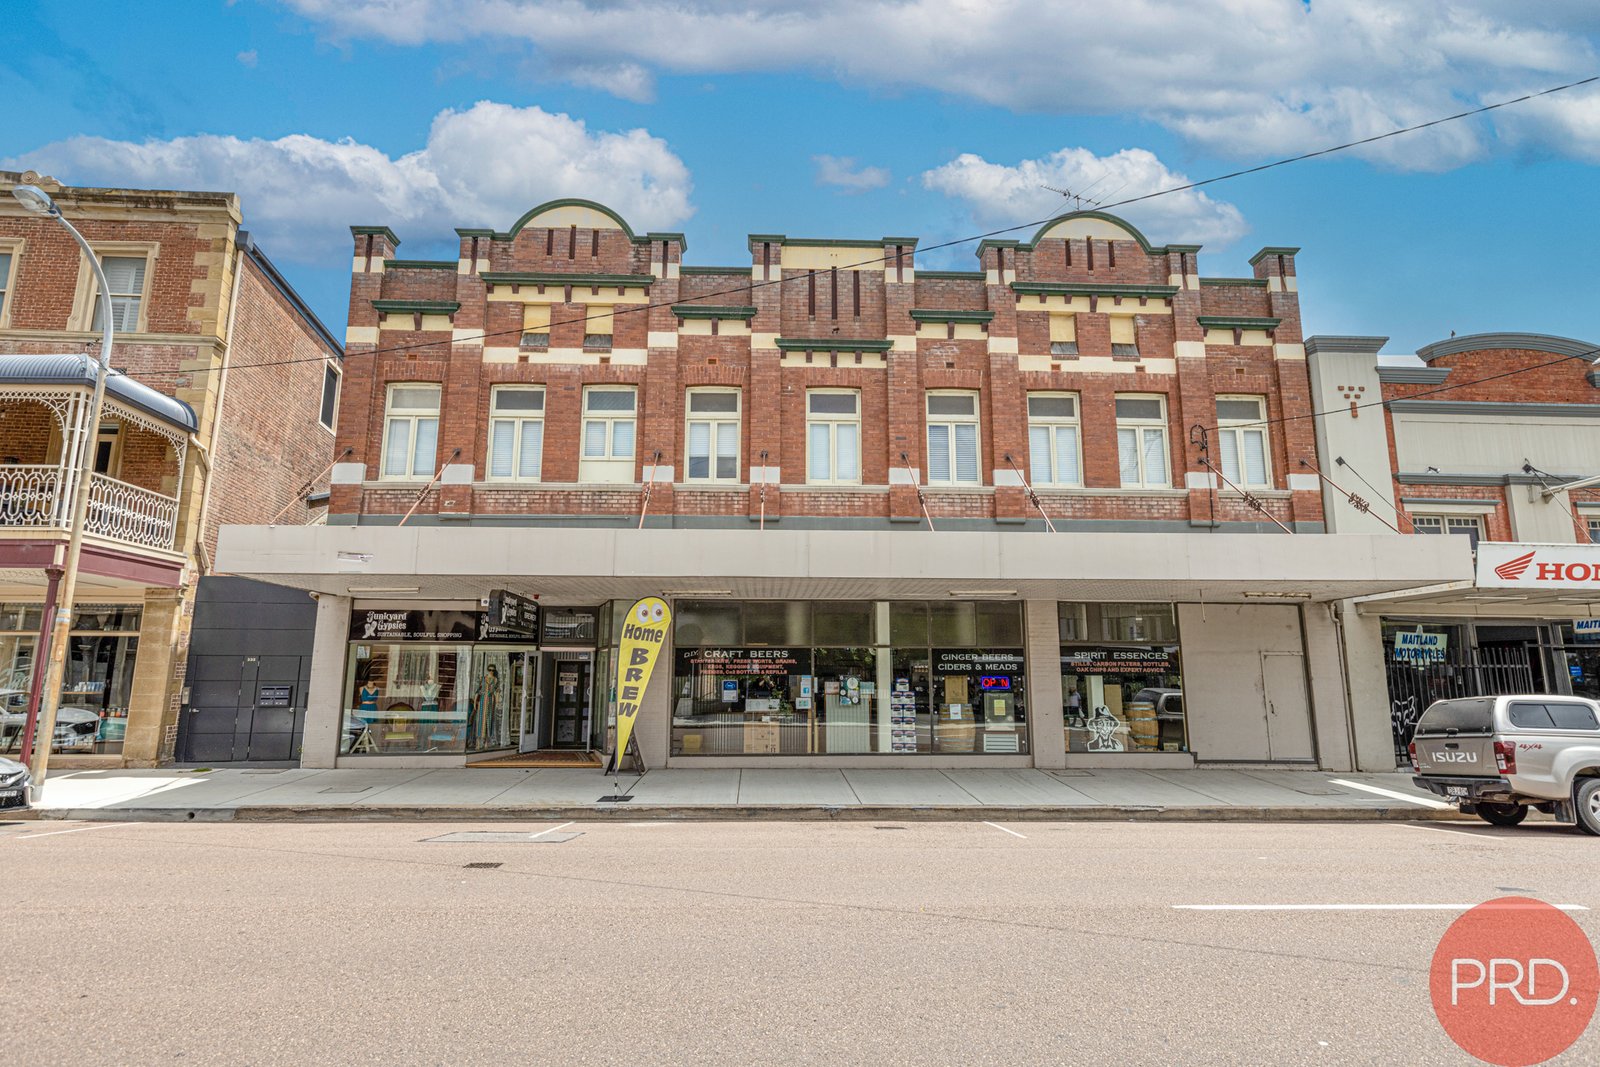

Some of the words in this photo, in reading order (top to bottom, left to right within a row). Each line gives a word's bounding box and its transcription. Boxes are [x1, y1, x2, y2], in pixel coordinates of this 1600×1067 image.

[366, 611, 407, 623] Junkyard
[377, 620, 407, 631] Gypsies
[1576, 620, 1600, 629] MAIT
[623, 623, 663, 643] Home
[1401, 633, 1438, 646] MAITLAND
[704, 650, 743, 658] CRAFT
[750, 650, 788, 658] BEERS
[1113, 652, 1168, 660] ESSENCES
[938, 663, 972, 671] CIDERS
[975, 663, 982, 671] &
[985, 663, 1018, 671] MEADS
[983, 678, 1008, 687] OPN
[1431, 752, 1477, 763] ISUZU
